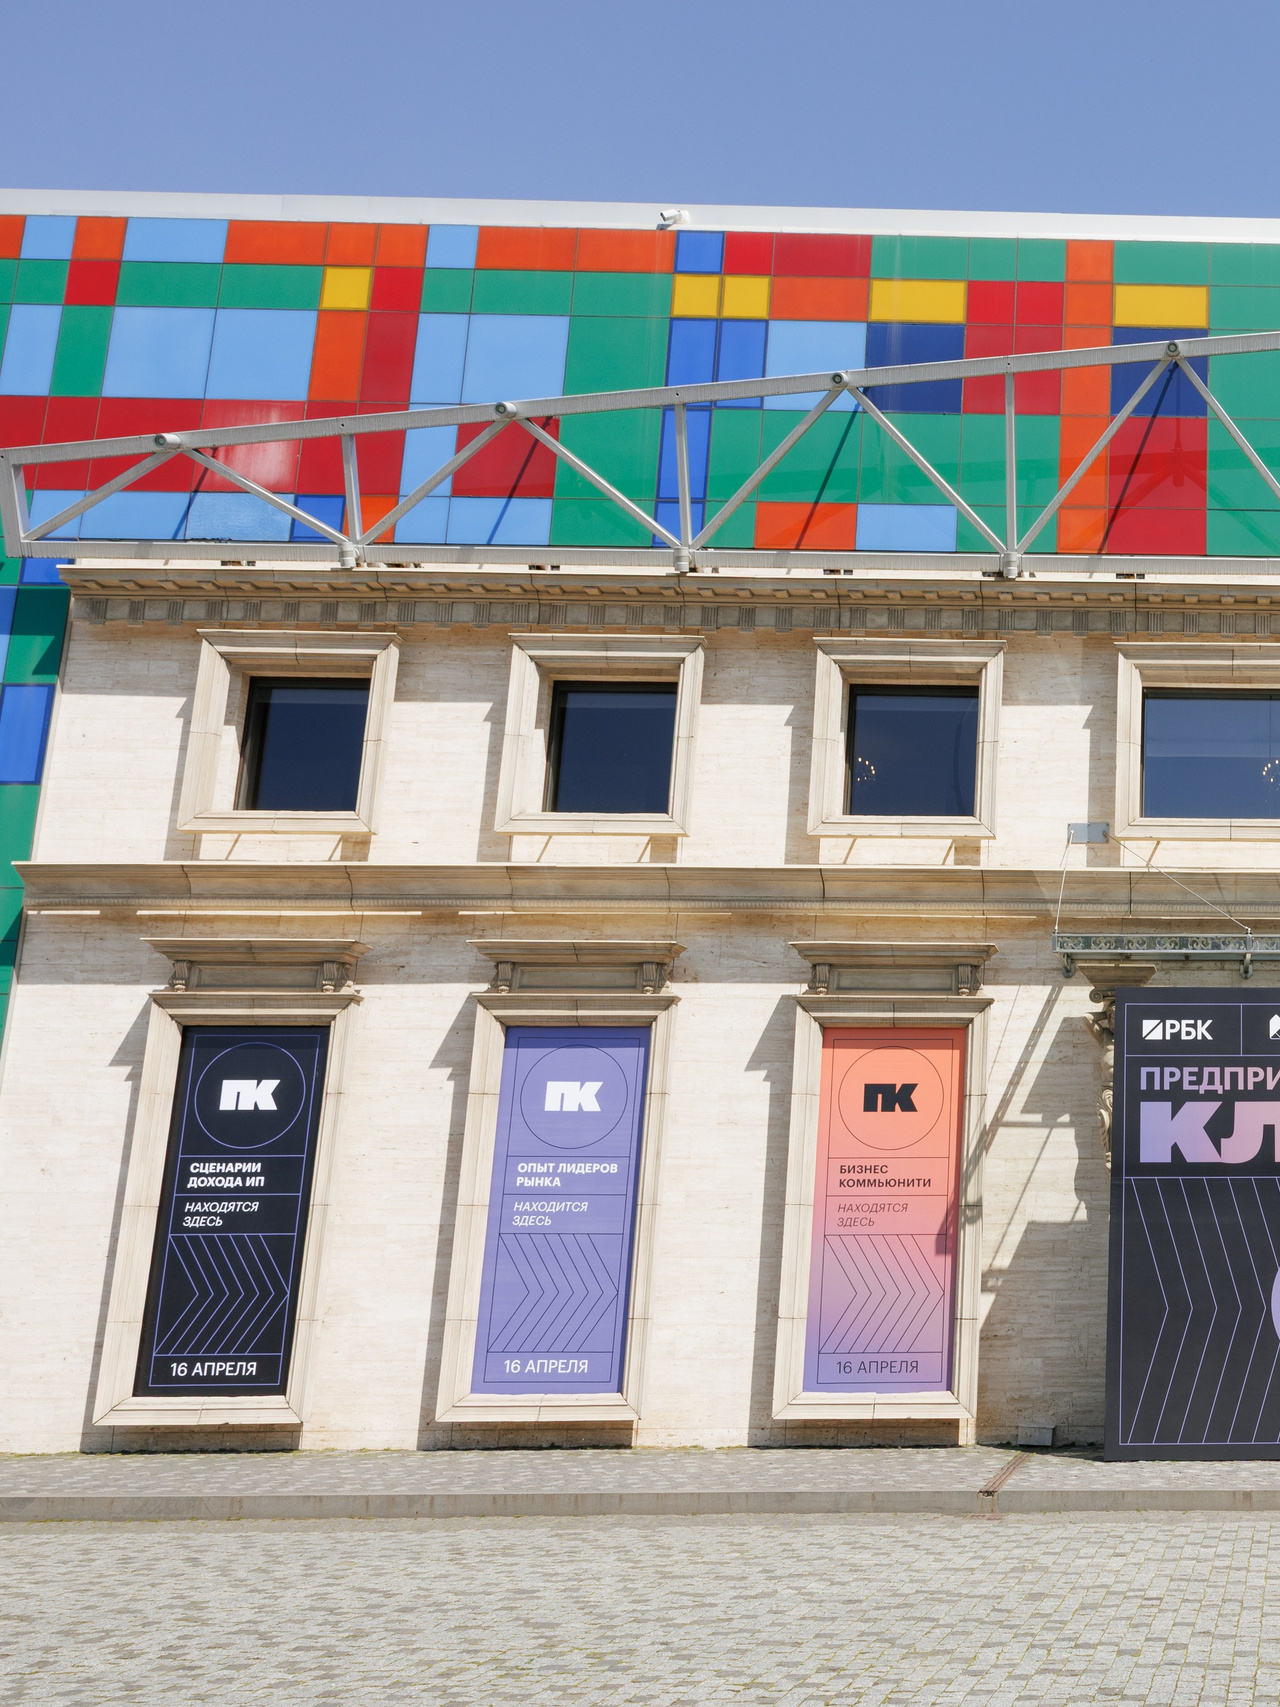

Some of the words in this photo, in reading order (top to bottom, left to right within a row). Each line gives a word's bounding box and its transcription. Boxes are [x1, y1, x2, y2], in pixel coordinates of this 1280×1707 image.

[1165, 1019, 1213, 1041] РБК
[219, 1079, 280, 1110] ПК
[544, 1081, 604, 1112] ПК
[862, 1083, 919, 1113] ПК
[190, 1162, 262, 1174] СЦЕНАРИИ
[517, 1163, 556, 1173] ОПЫТ
[557, 1163, 618, 1175] ЛИДЕРОВ
[839, 1164, 889, 1174] БИЗНЕС
[187, 1176, 243, 1189] ДОХОДА
[245, 1176, 265, 1187] ИП
[516, 1176, 561, 1187] РЫНКА
[838, 1178, 932, 1188] КОММЬЮНИТИ
[184, 1201, 259, 1213] НАХОДЯТСЯ
[513, 1202, 588, 1214] НАХОДИТСЯ
[837, 1203, 909, 1215] НАХОДЯТСЯ
[182, 1216, 223, 1228] ЗДЕСЬ
[512, 1215, 552, 1228] ЗДЕСЬ
[836, 1217, 875, 1228] ЗДЕСЬ
[170, 1362, 188, 1377] 16
[191, 1362, 257, 1377] АПРЕЛЯ
[504, 1359, 521, 1373] 16
[525, 1359, 588, 1373] АПРЕЛЯ
[836, 1361, 852, 1374] 16
[856, 1360, 919, 1374] АПРЕЛЯ
